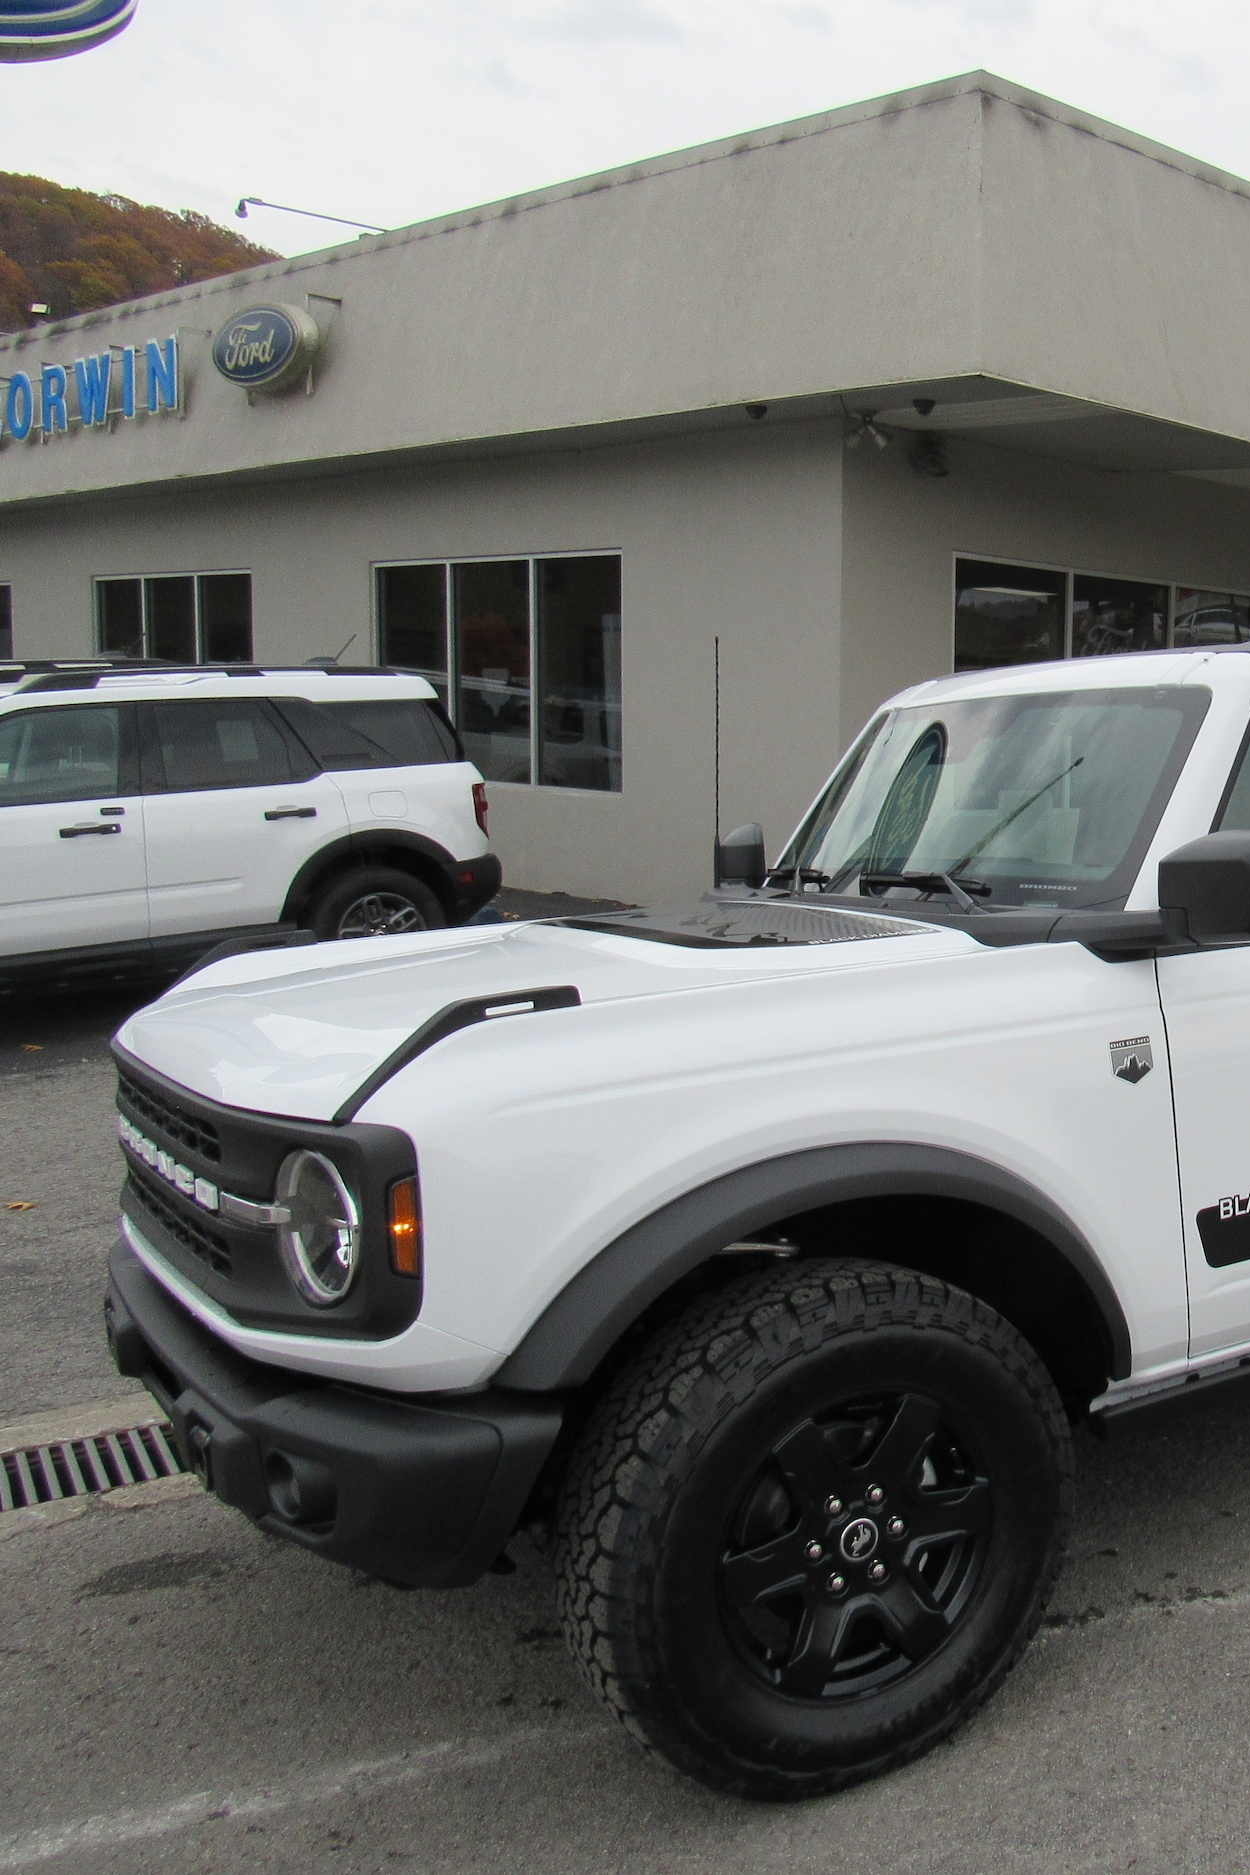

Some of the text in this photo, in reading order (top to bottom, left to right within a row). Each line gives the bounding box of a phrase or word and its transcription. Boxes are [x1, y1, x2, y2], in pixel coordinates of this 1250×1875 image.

[225, 322, 275, 370] Ford
[0, 334, 178, 442] ORWIN
[808, 928, 935, 945] BLACK DIAMOND
